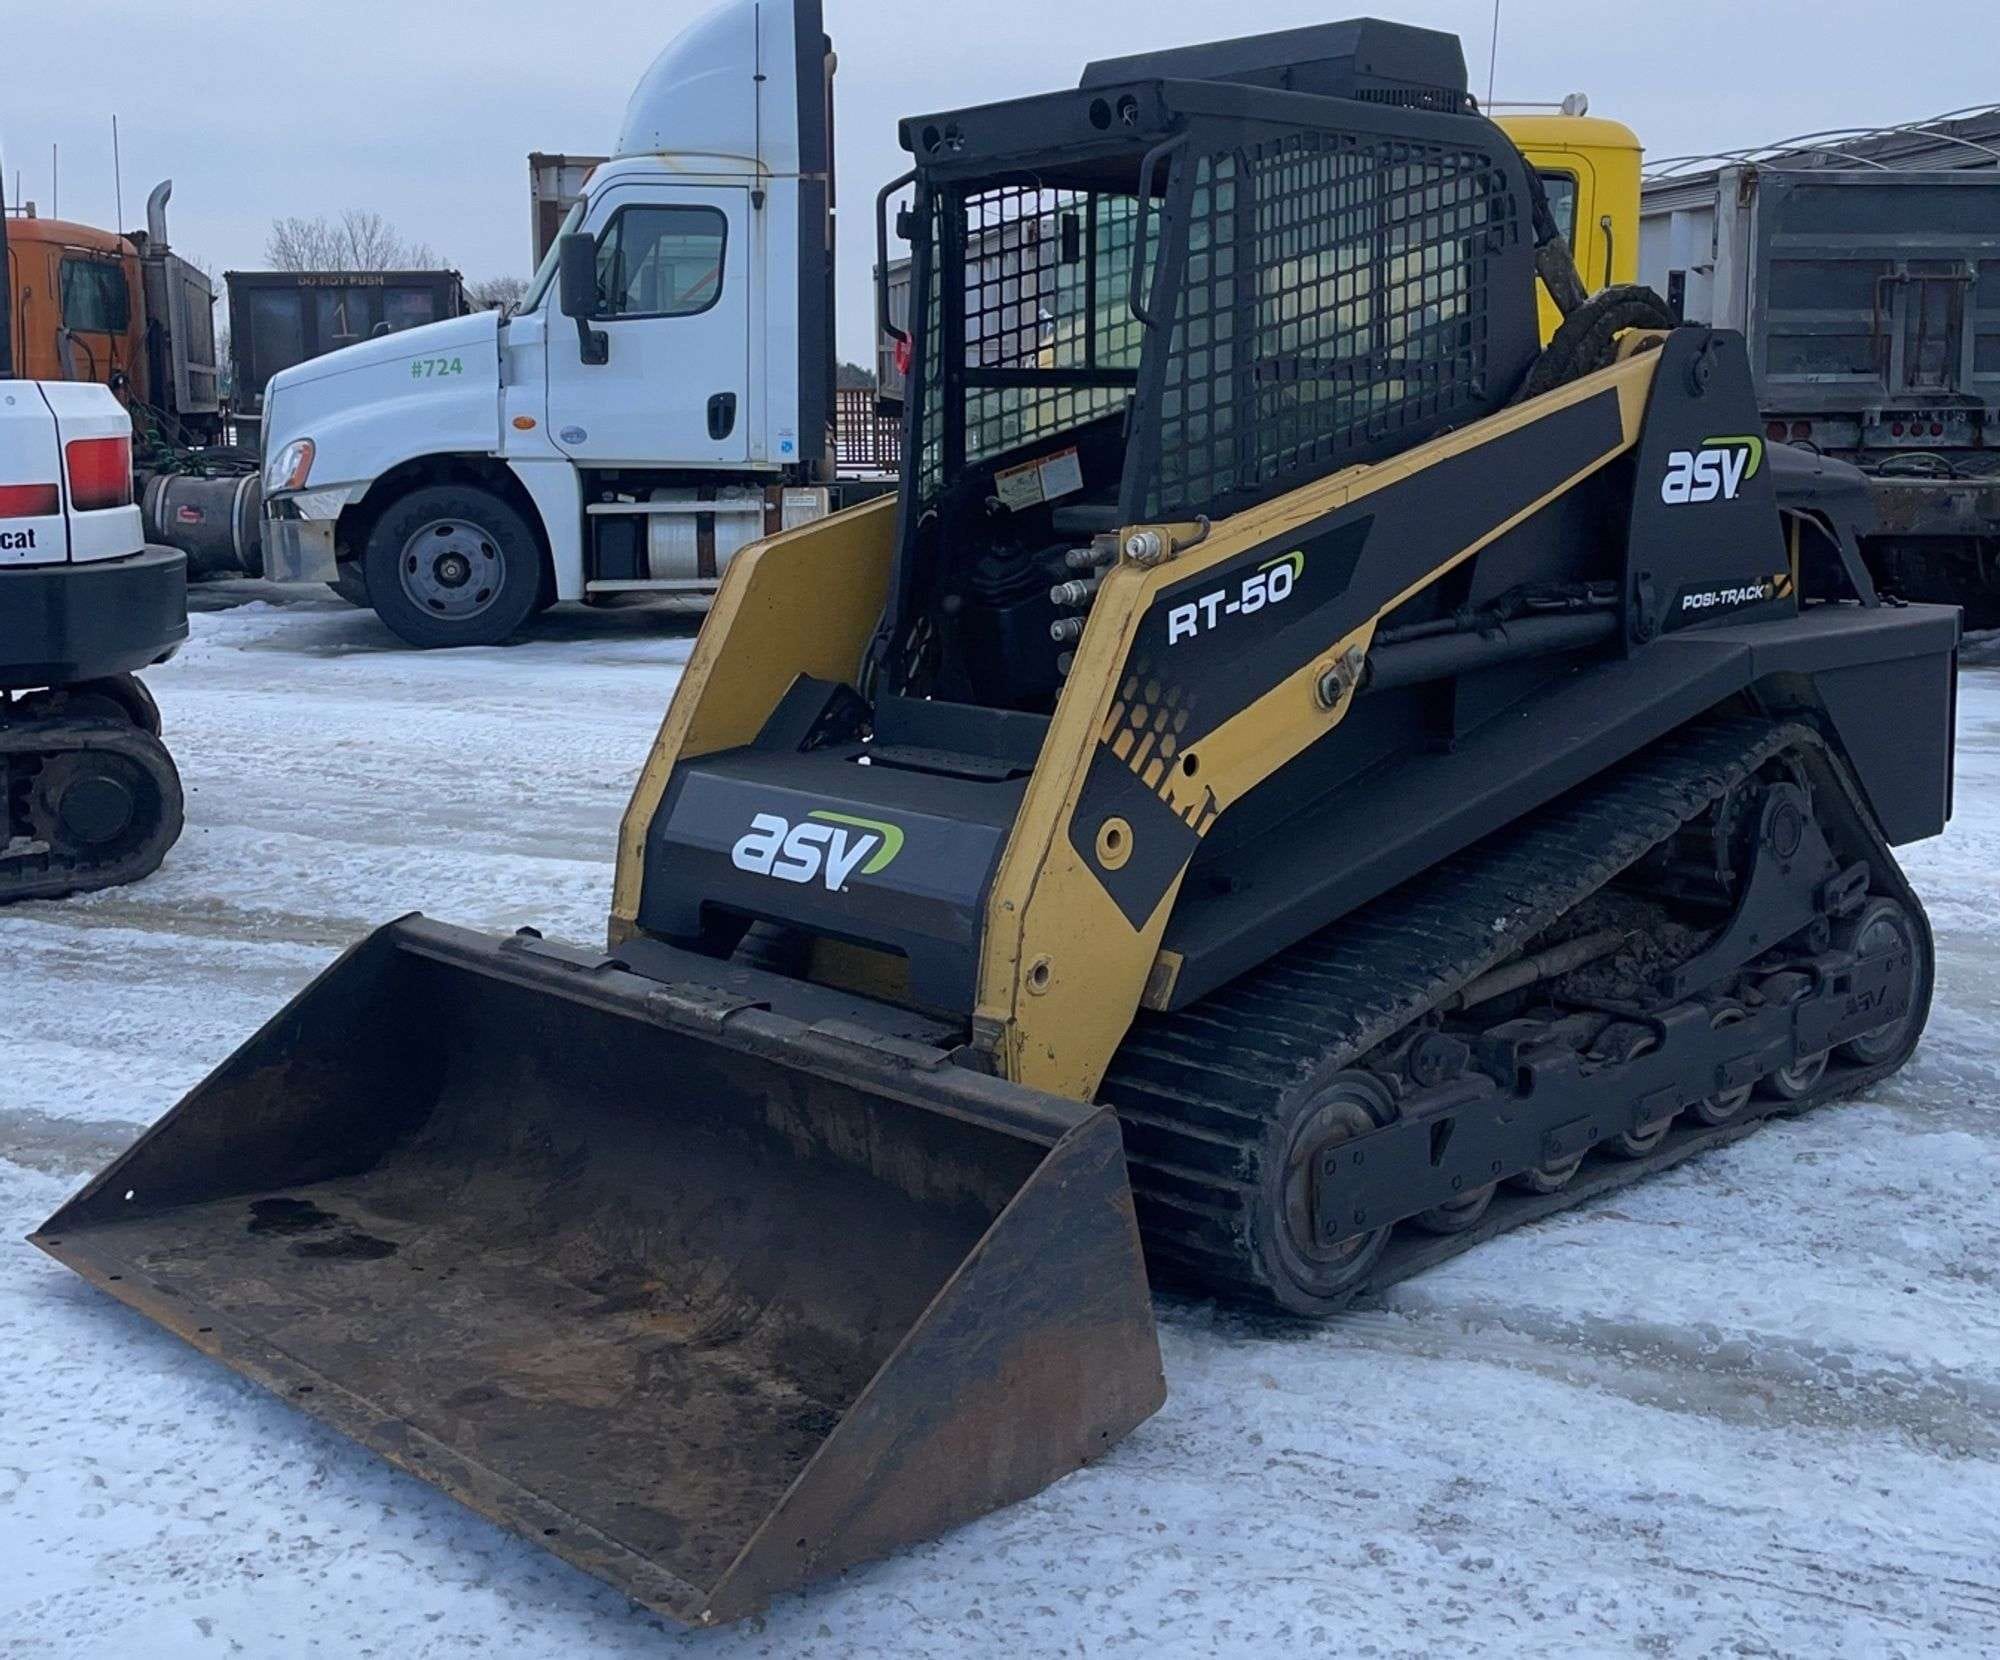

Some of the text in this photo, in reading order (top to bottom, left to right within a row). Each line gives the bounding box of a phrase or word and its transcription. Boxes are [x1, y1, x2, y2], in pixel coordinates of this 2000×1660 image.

[320, 276, 345, 286] NOT
[350, 276, 384, 286] PUSH
[331, 302, 359, 338] 1
[411, 357, 464, 379] #724
[0, 528, 36, 550] cat
[1168, 563, 1293, 646] RT-50
[1681, 584, 1766, 611] POSI-TRACK
